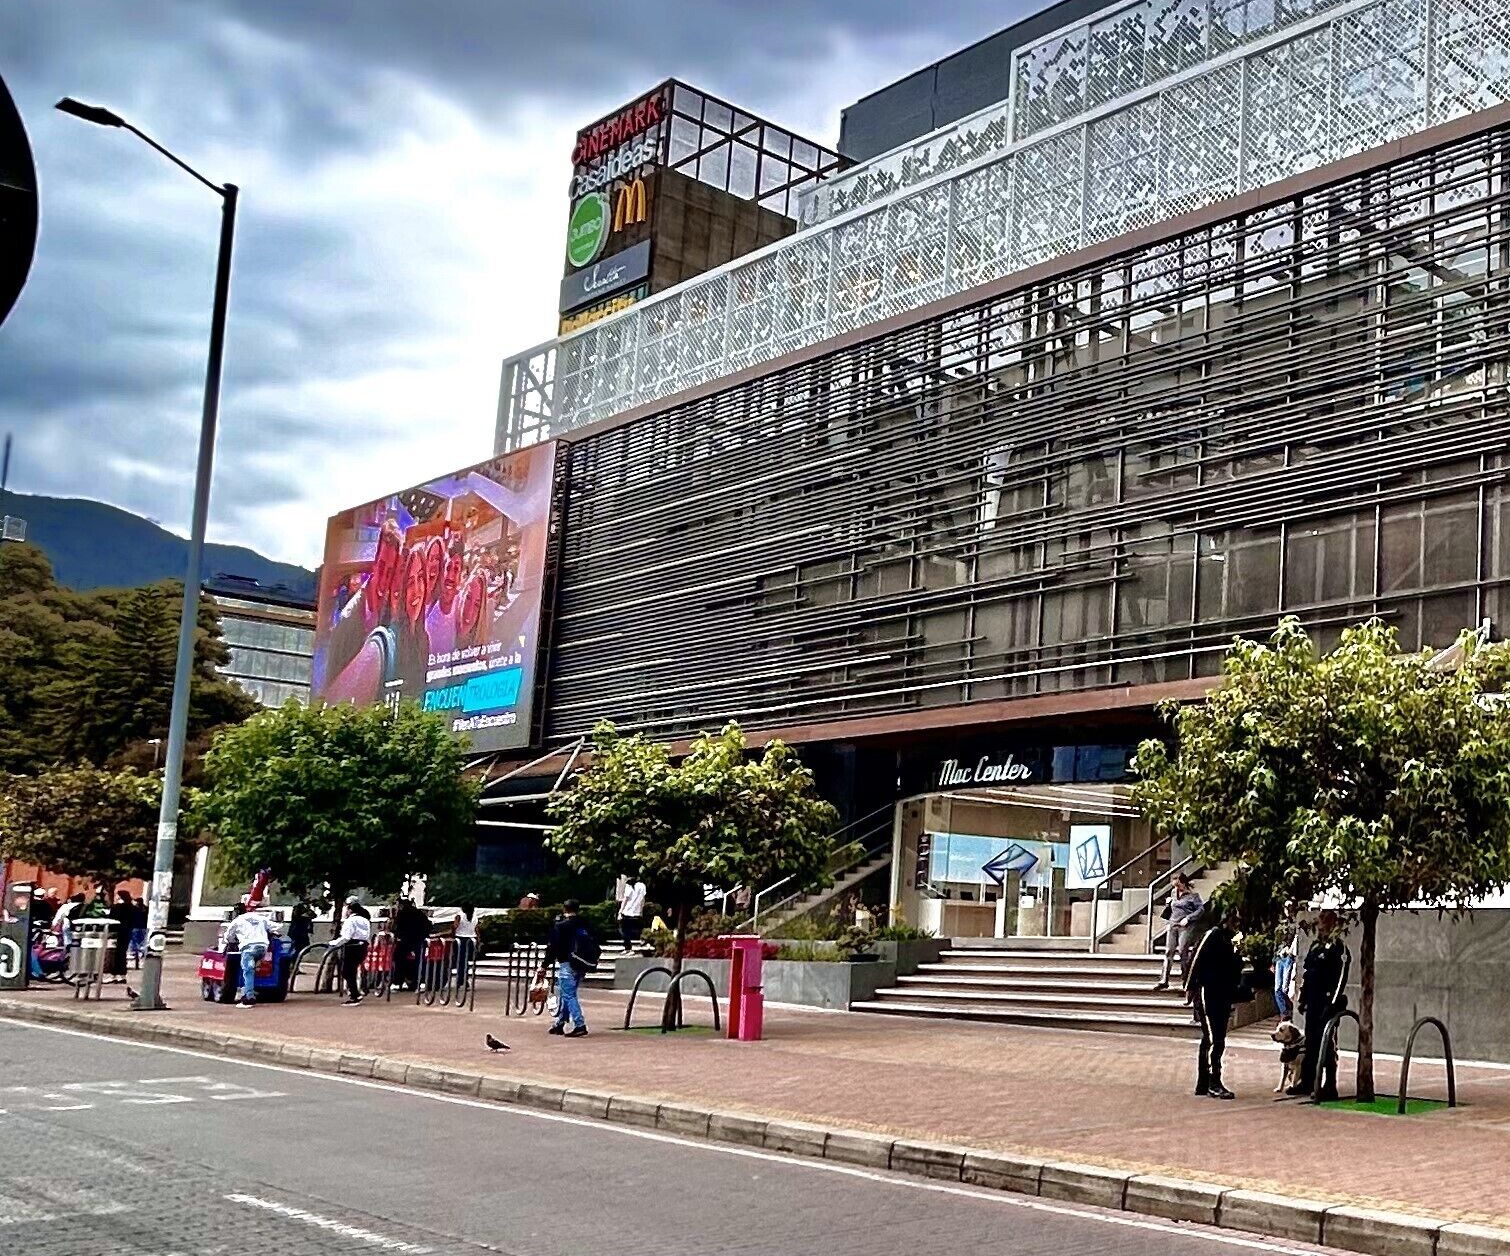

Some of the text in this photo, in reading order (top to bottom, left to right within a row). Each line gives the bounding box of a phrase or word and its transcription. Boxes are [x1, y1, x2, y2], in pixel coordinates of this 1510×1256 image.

[572, 100, 660, 165] CINEMARK
[938, 754, 1032, 786] Mac Center
